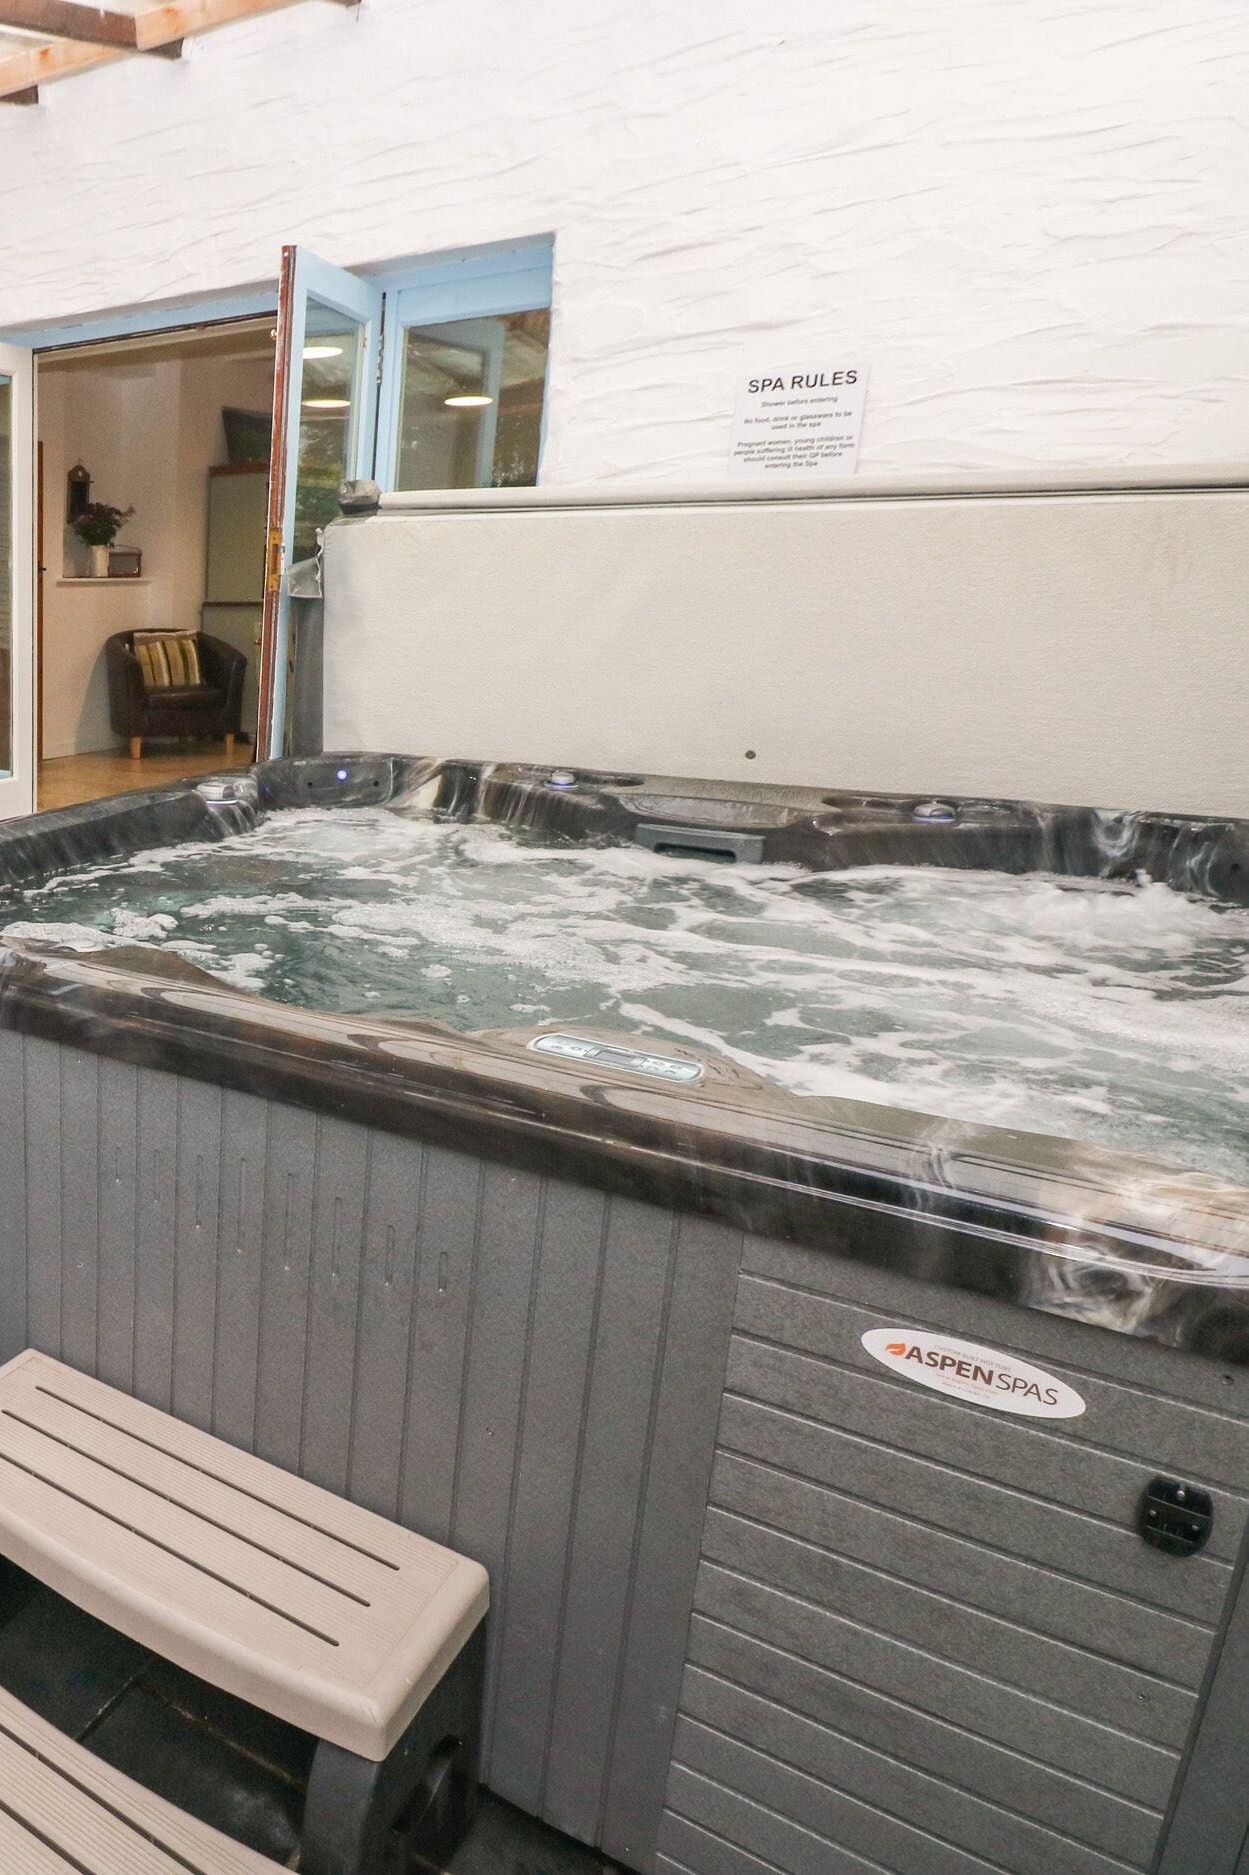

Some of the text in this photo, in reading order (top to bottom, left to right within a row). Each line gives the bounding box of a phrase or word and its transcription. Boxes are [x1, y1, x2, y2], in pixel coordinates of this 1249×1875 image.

[748, 370, 858, 393] SPA RULES
[761, 396, 838, 408] Shower before entering
[800, 412, 833, 421] glassware
[808, 421, 822, 429] spa
[737, 440, 766, 448] Pregnant
[733, 448, 755, 456] people
[764, 461, 791, 469] entering
[905, 1346, 994, 1385] ASPEN
[995, 1373, 1059, 1405] SPAS
